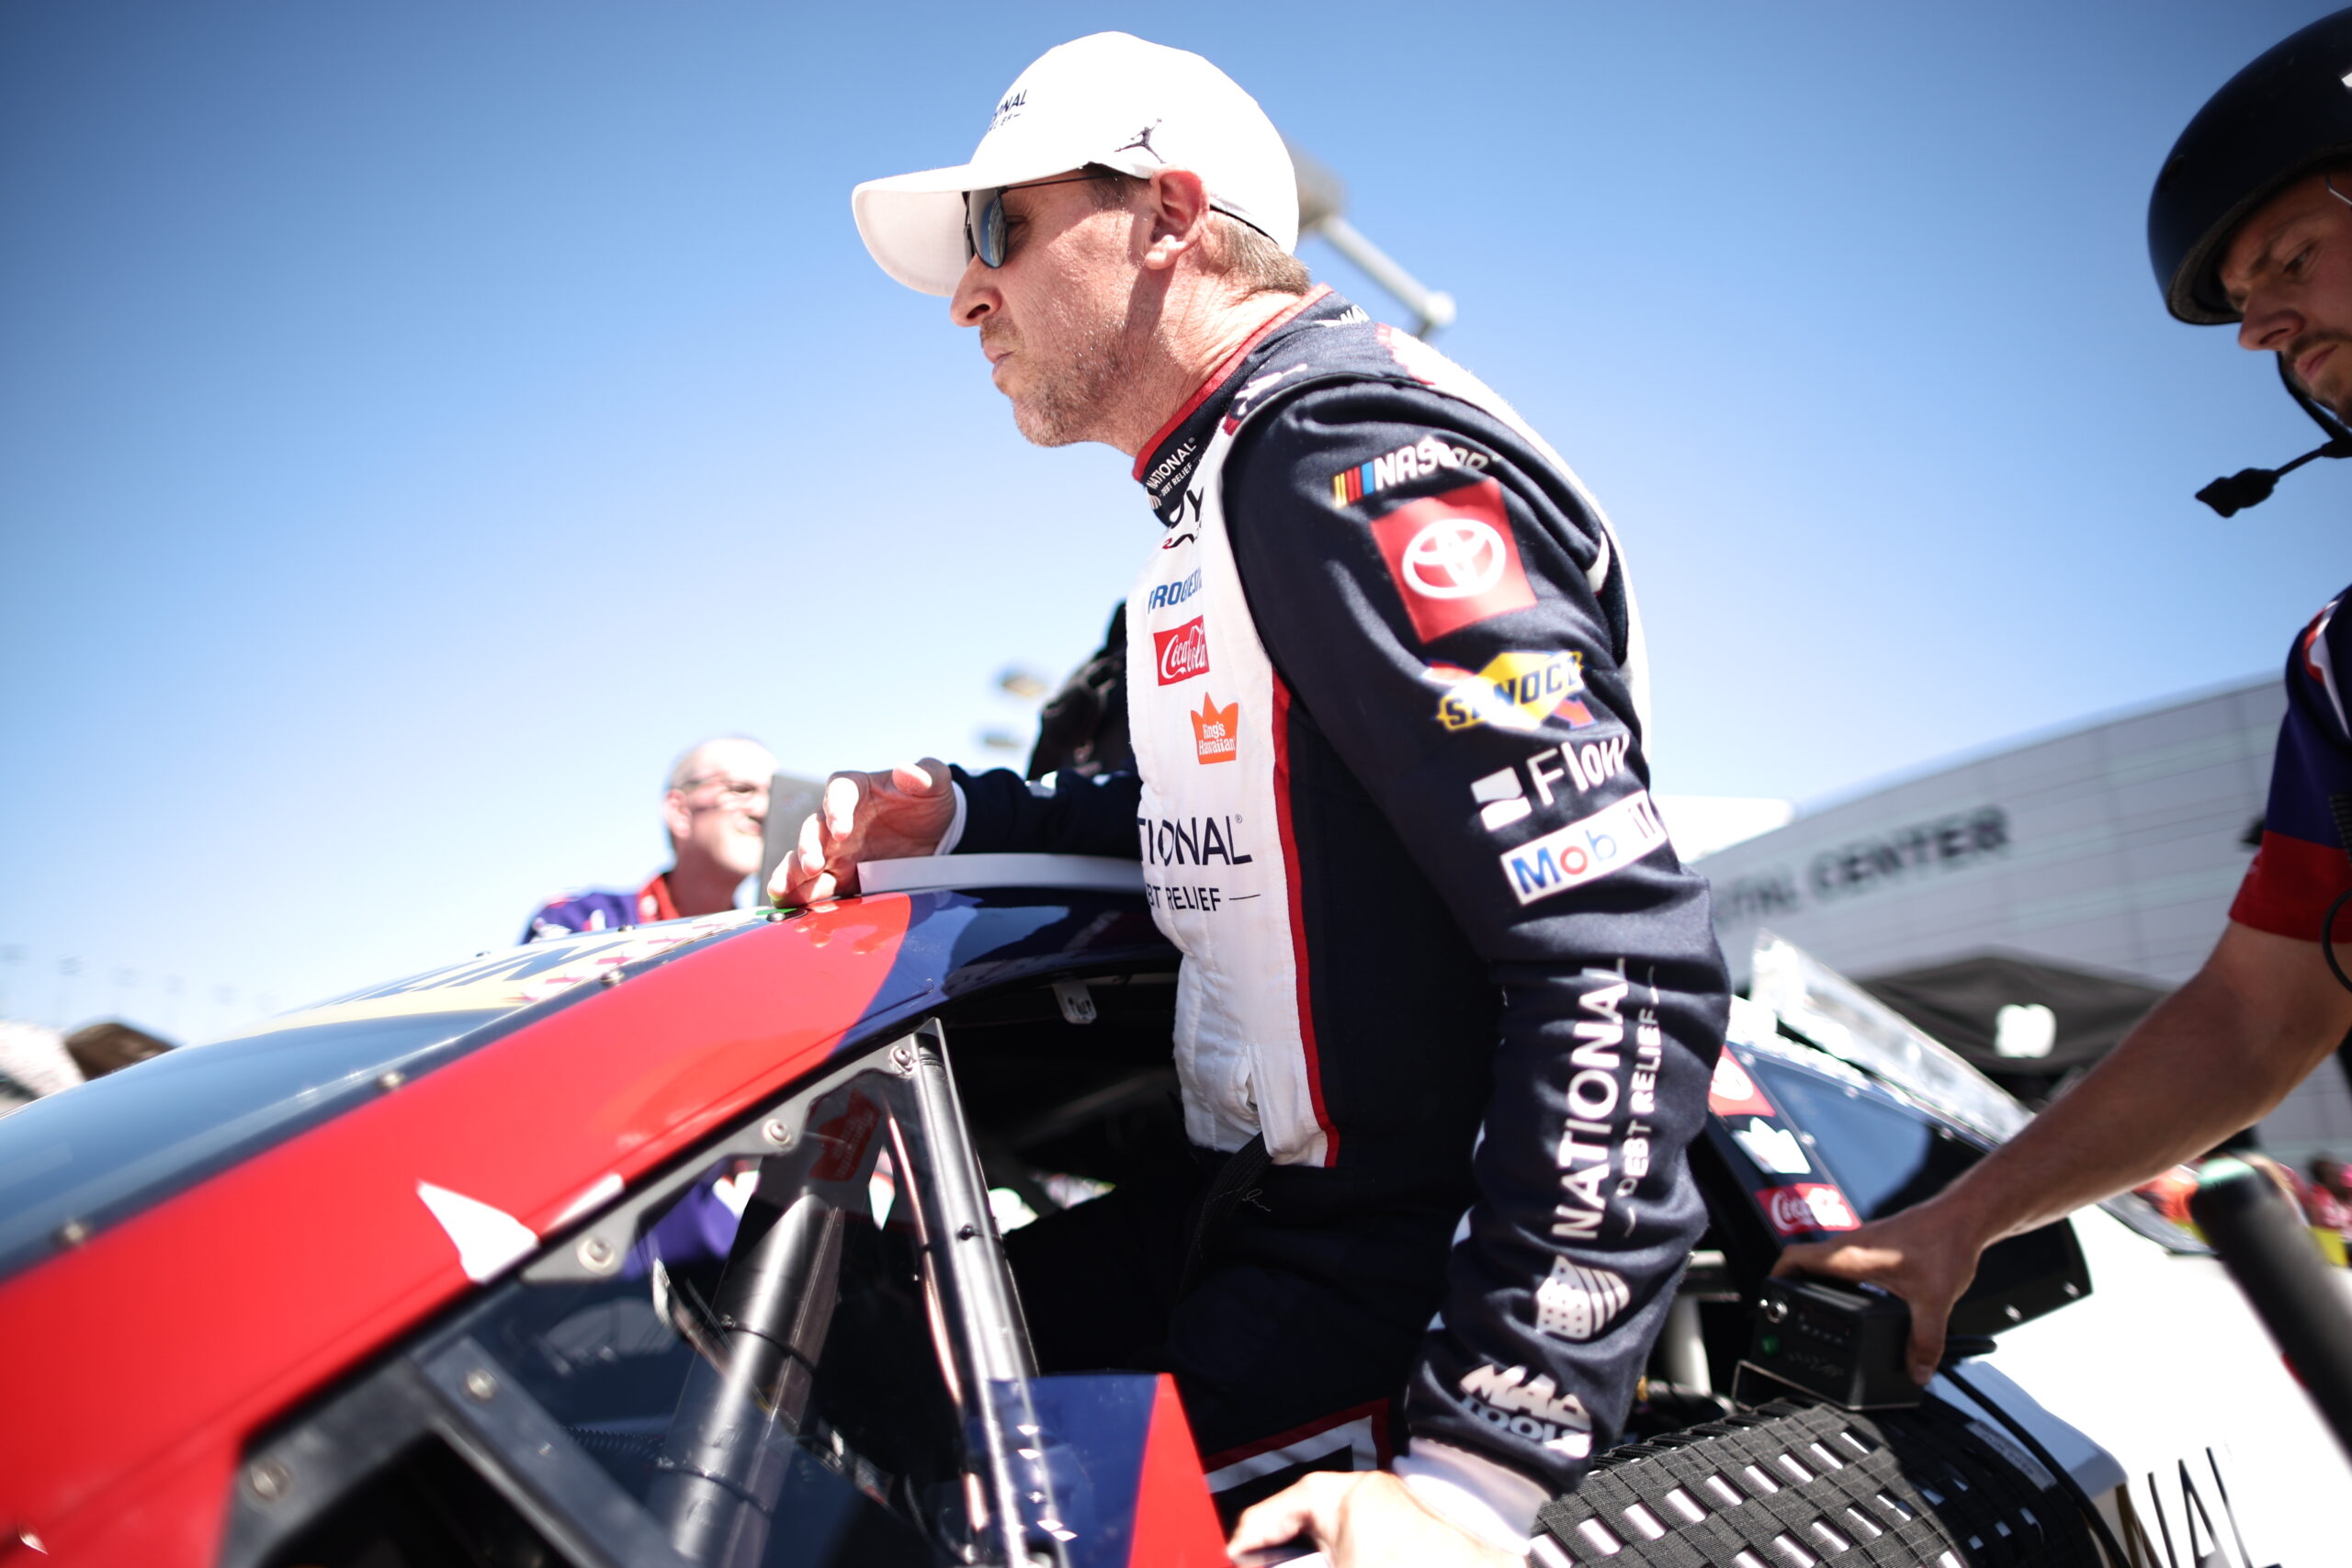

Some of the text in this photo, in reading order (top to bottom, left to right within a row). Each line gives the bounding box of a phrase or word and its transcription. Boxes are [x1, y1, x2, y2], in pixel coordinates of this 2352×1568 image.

[1171, 462, 1193, 486] RELIEF
[1445, 656, 1582, 727] SNOC
[1199, 738, 1236, 756] Hawaiian
[1526, 733, 1630, 807] Flow
[1166, 886, 1221, 911] RELIEF
[1552, 957, 1629, 1239] NATIONAL
[1615, 1009, 1661, 1197] DEBT RELIEF
